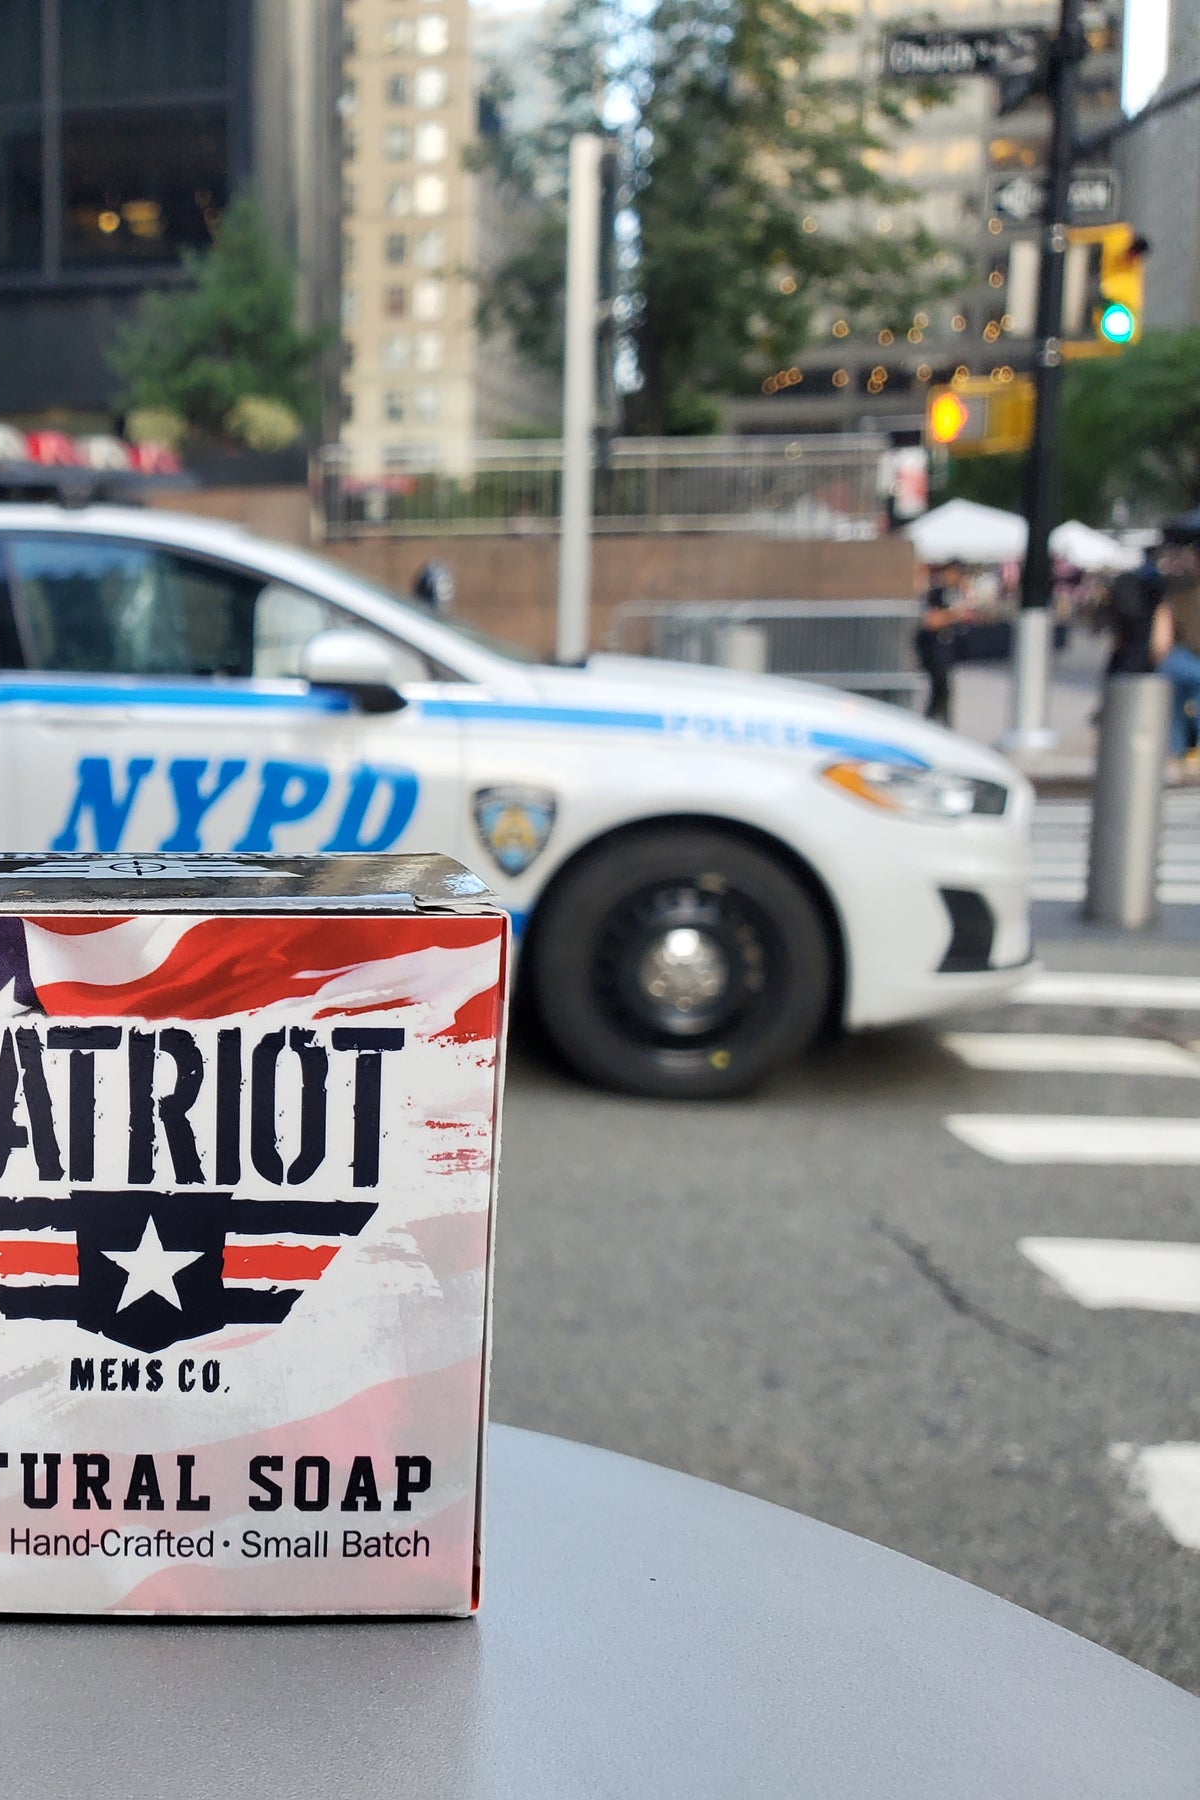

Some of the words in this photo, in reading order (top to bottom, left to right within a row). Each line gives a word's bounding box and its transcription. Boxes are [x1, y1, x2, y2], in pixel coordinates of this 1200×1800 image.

[667, 712, 806, 747] POLICE
[50, 756, 421, 852] NYPD
[69, 1357, 165, 1393] MENS
[177, 1358, 231, 1394] CO.
[248, 1455, 433, 1513] SOAP
[9, 1528, 215, 1559] Hand-Crafted
[240, 1530, 328, 1559] Small
[342, 1531, 432, 1559] Batch
